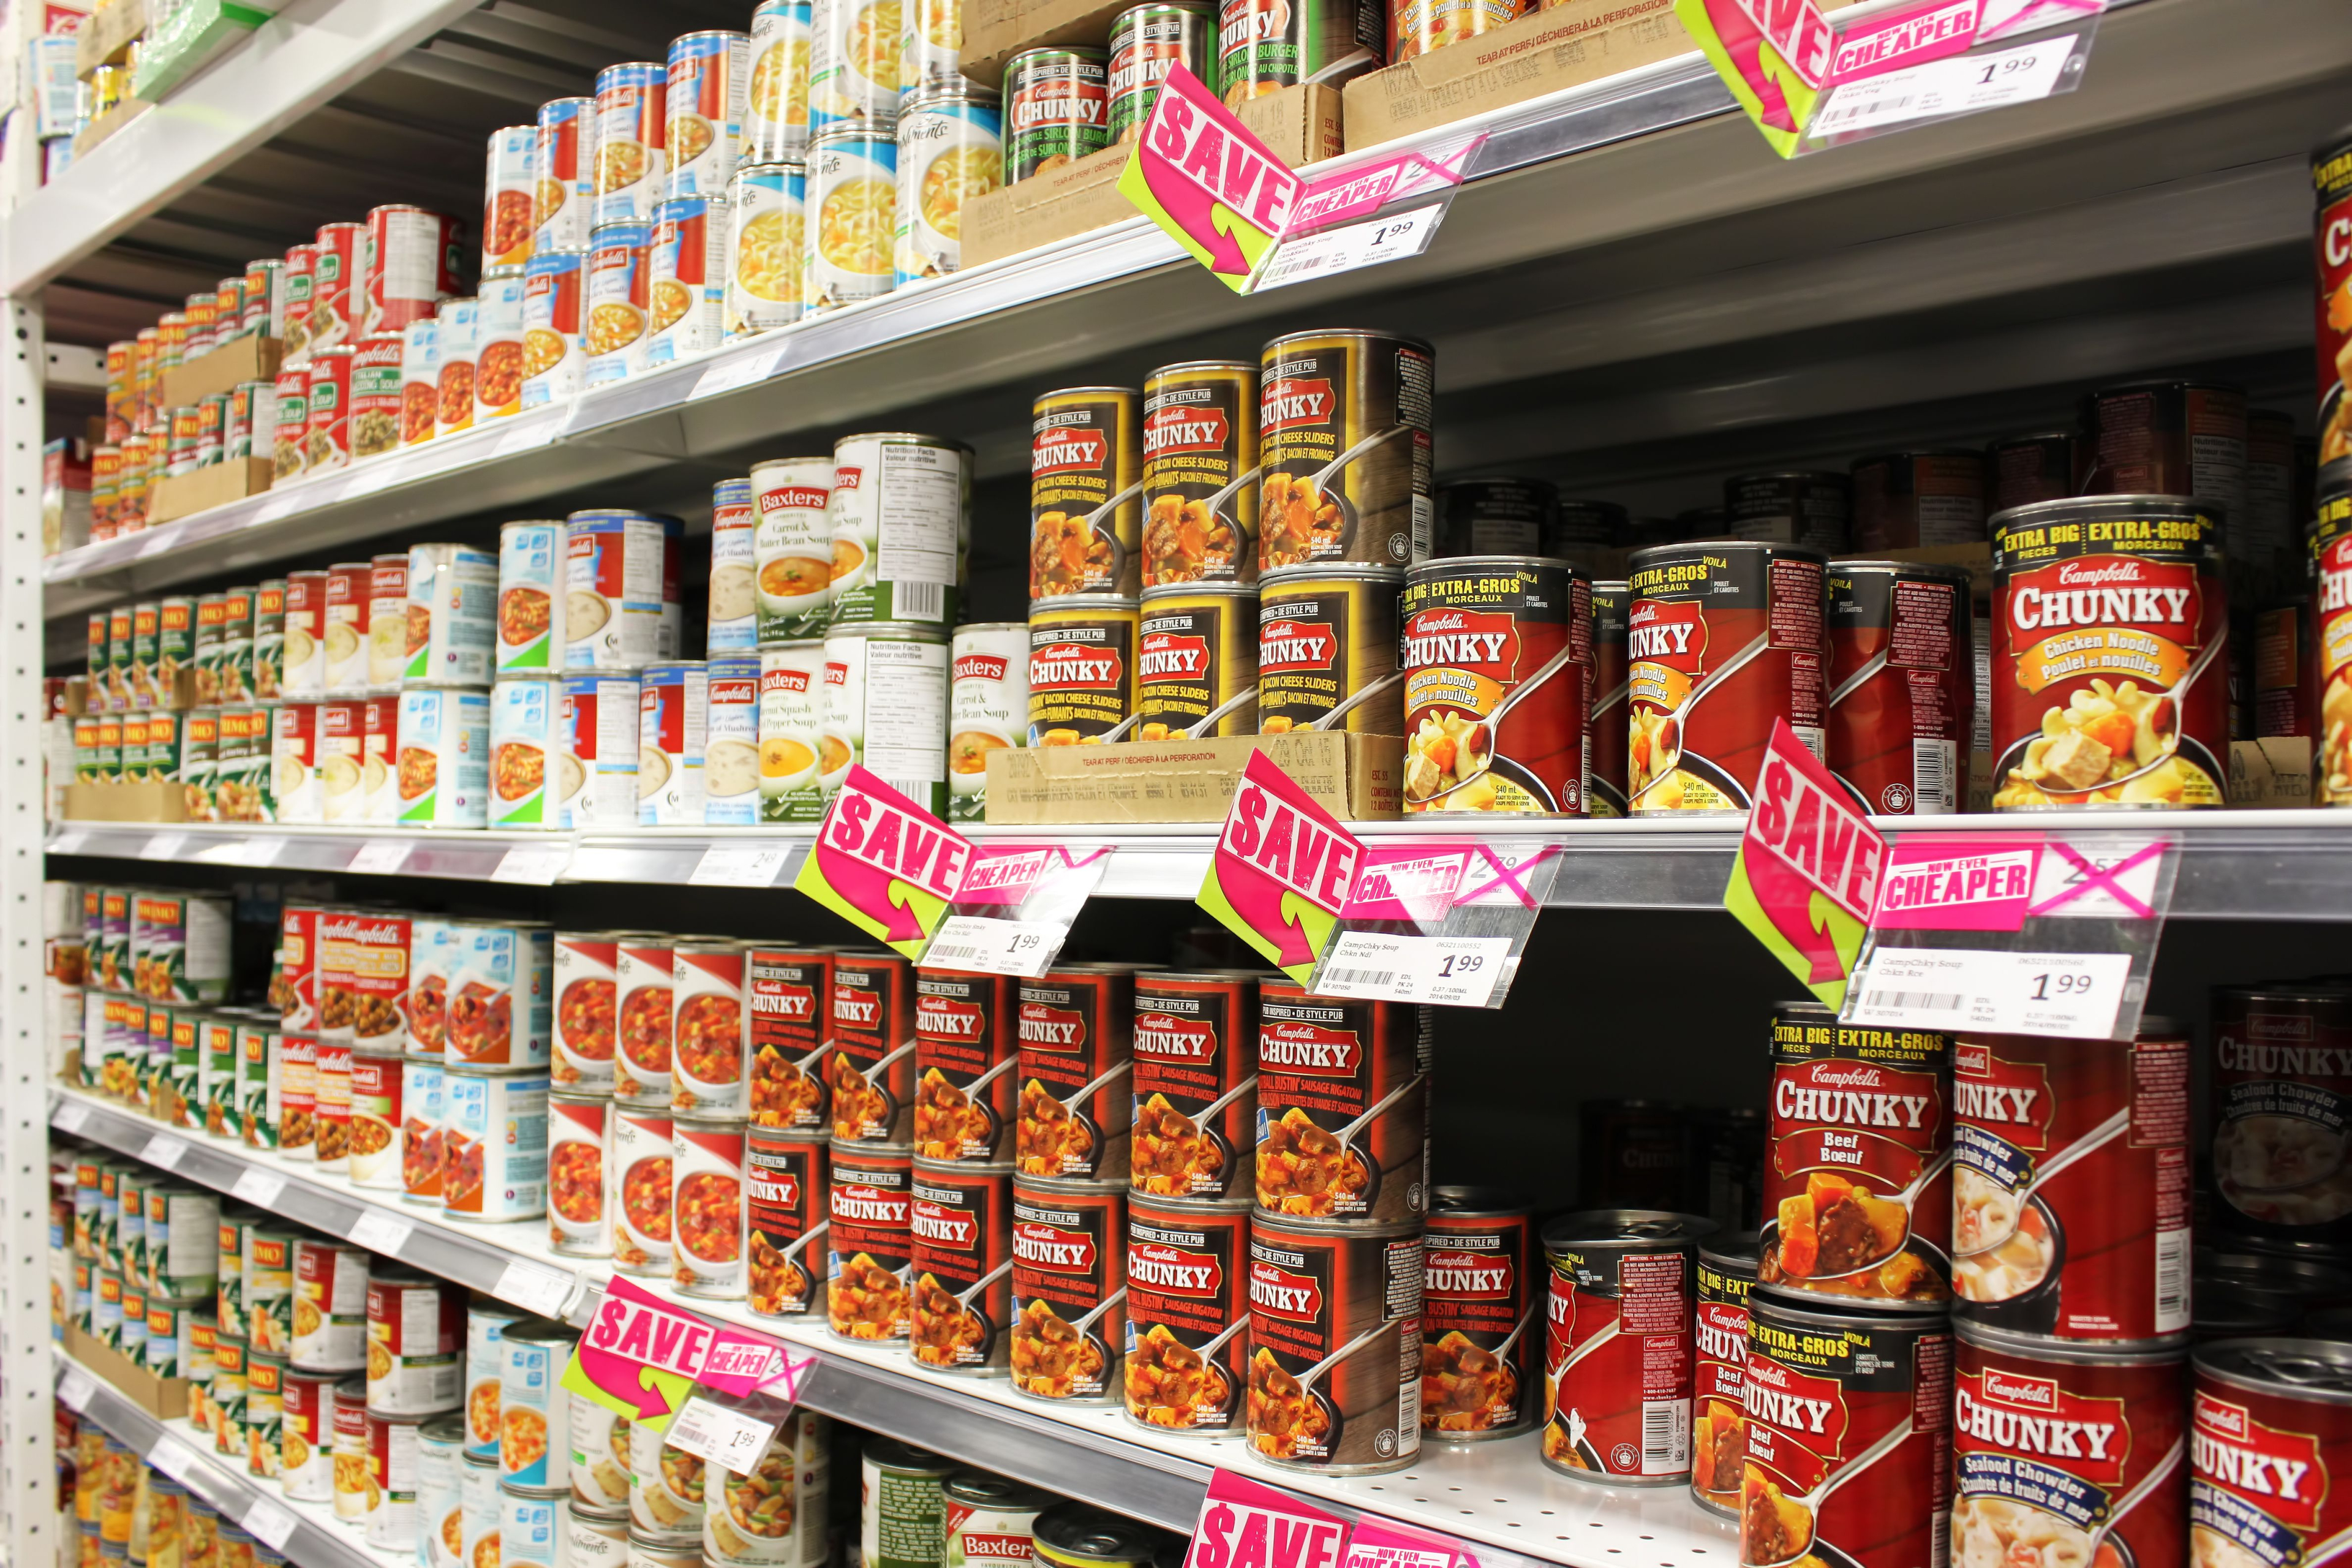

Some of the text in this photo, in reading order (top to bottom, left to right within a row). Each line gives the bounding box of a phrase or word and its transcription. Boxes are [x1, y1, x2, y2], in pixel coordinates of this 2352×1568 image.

[1536, 23, 1581, 45] DÉCHIRER
[1258, 43, 1298, 59] BURGER
[1259, 62, 1298, 74] AU CHIPOTLE
[1018, 98, 1102, 124] CHUNKY
[1329, 177, 1370, 197] NOW EVEN
[1178, 391, 1211, 402] STYLE PUB
[1280, 432, 1335, 445] CHEESE SLIDERS
[884, 446, 936, 456] Nutrition Facts
[761, 489, 827, 511] Baxters
[2004, 521, 2201, 552] EXTRA BIG EXTRA-GROS
[2018, 540, 2184, 560] PIECES MORCEAUX
[1432, 571, 1537, 597] EXTRA-GROS VOILÀ
[2059, 562, 2141, 586] Campbell's
[1446, 595, 1502, 604] MORCEAUX
[2013, 587, 2190, 630] CHUNKY
[1416, 614, 1464, 633] Campbell's
[1404, 634, 1506, 669] CHUNKY
[2044, 632, 2160, 660] Chicken Noodle
[952, 660, 1002, 681] Baxters
[1030, 660, 1112, 685] CHUNKY
[2041, 653, 2162, 680] Poulet et nouilles
[1280, 676, 1337, 692] CHEESE SLIDERS
[1409, 671, 1477, 693] Chicken Noodle
[1408, 692, 1428, 710] Poulet
[1436, 689, 1478, 707] nouilles
[780, 703, 811, 717] Squash
[983, 707, 1009, 720] Soup
[792, 717, 816, 729] Soup
[1125, 756, 1155, 764] DÉCHIRER
[1170, 753, 1215, 762] PERFORATION
[1412, 859, 1434, 869] EVEN
[1928, 857, 1988, 874] NOW EVEN
[1344, 941, 1381, 951] CampChky
[1270, 1007, 1291, 1017] INSPIRED
[1306, 1010, 1327, 1019] STYLE
[1329, 1011, 1343, 1020] PUB
[1276, 1024, 1314, 1040] Campbell's
[1774, 1025, 1944, 1052] EXTRA BIG EXTRA-GROS
[1261, 1034, 1351, 1068] CHUNKY
[1782, 1044, 1926, 1060] PIECES MORCEAUX
[1811, 1064, 1880, 1088] Campbell's
[1301, 1080, 1330, 1095] SAUSAGE
[1330, 1085, 1362, 1099] RIGATONI
[1776, 1079, 1928, 1129] CHUNKY
[1824, 1131, 1859, 1149] Beef
[1012, 1233, 1087, 1266] CHUNKY
[1465, 1237, 1501, 1247] STYLE PUB
[1128, 1251, 1212, 1289] CHUNKY
[1460, 1305, 1488, 1316] SAUSAGE
[1758, 1325, 1871, 1358] EXTRA-GROS VOILÀ
[1770, 1348, 1828, 1366] MORCEAUX
[1750, 1424, 1772, 1446] Beef
[1955, 1389, 2115, 1461] CHUNKY
[1965, 1455, 2087, 1499] Seafood Chowder
[2014, 1479, 2047, 1504] fruits
[2067, 1501, 2093, 1523] mer
[1376, 1548, 1398, 1559] NOW
[1398, 1551, 1420, 1561] EVEN
